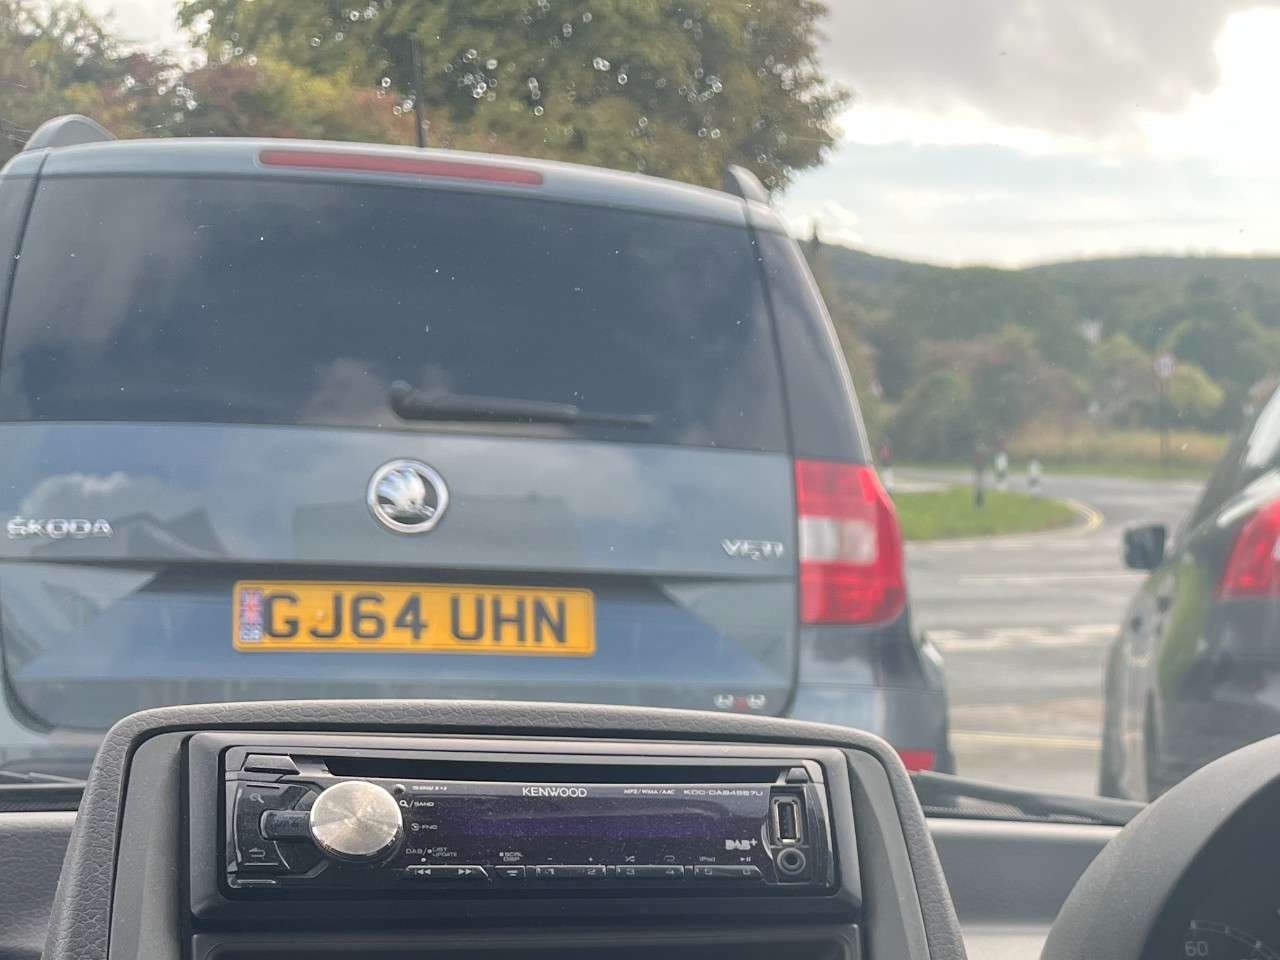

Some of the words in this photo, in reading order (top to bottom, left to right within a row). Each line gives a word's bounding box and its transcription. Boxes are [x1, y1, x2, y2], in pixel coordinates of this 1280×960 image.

[263, 592, 428, 641] GJ64
[450, 592, 568, 643] UHN
[522, 786, 588, 798] KENWOOD
[1184, 940, 1209, 957] 60
